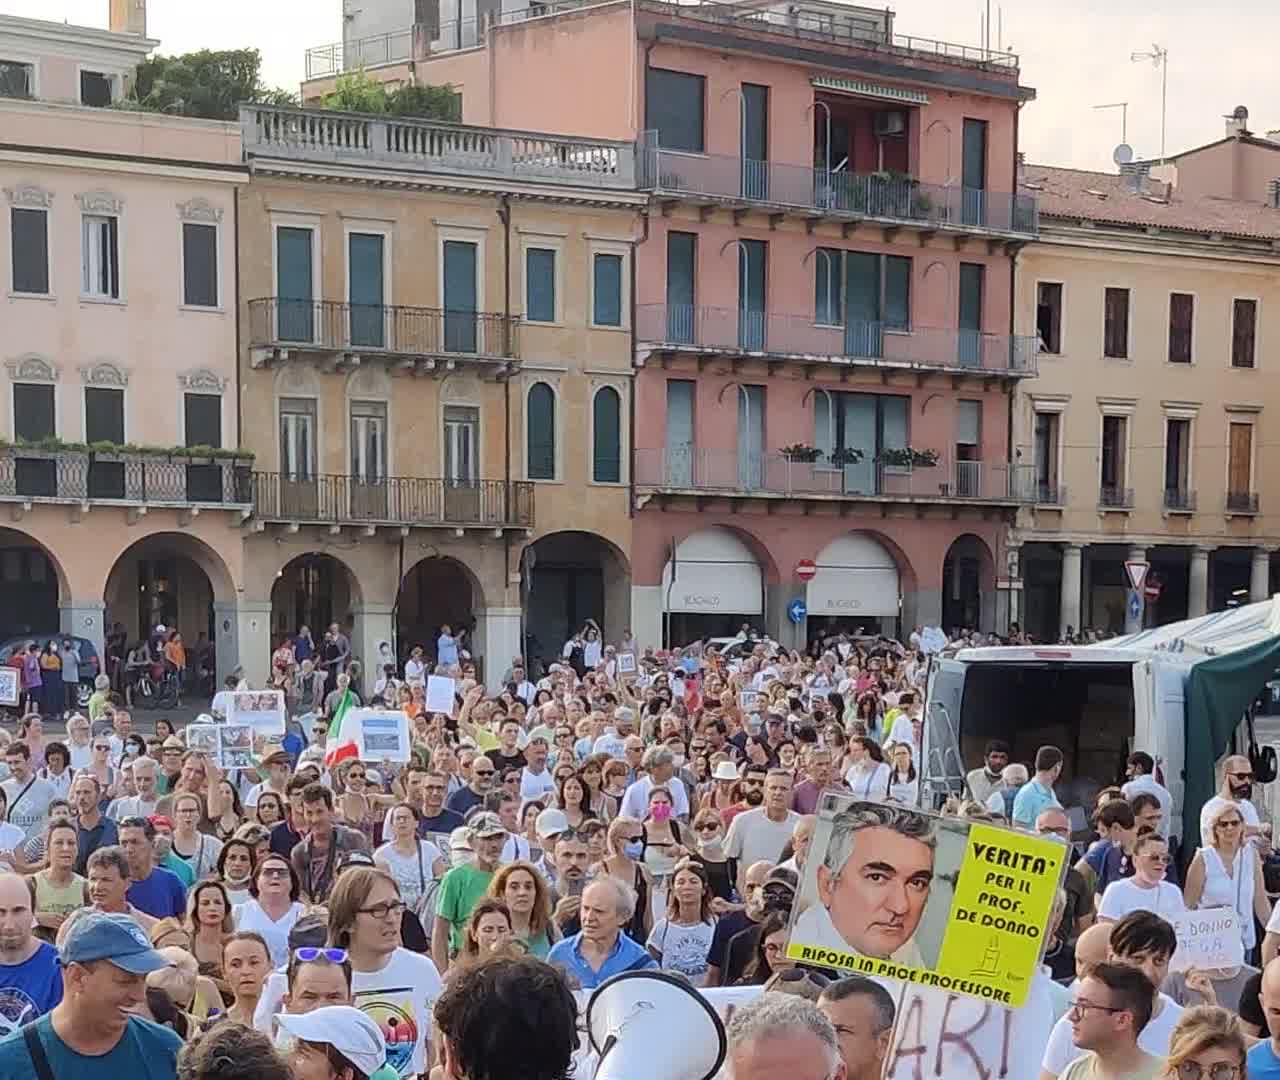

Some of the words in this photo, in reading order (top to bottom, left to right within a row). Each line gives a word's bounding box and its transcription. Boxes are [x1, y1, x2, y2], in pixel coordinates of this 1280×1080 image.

[985, 872, 1015, 890] PER
[1019, 879, 1031, 895] IL
[978, 892, 1026, 915] PROF.
[955, 909, 978, 924] DE
[981, 914, 1040, 938] DONNO
[801, 947, 855, 969] RIPOSA
[858, 957, 874, 973] IN
[877, 963, 917, 983] PACE
[920, 972, 1012, 1004] PROFESSORE
